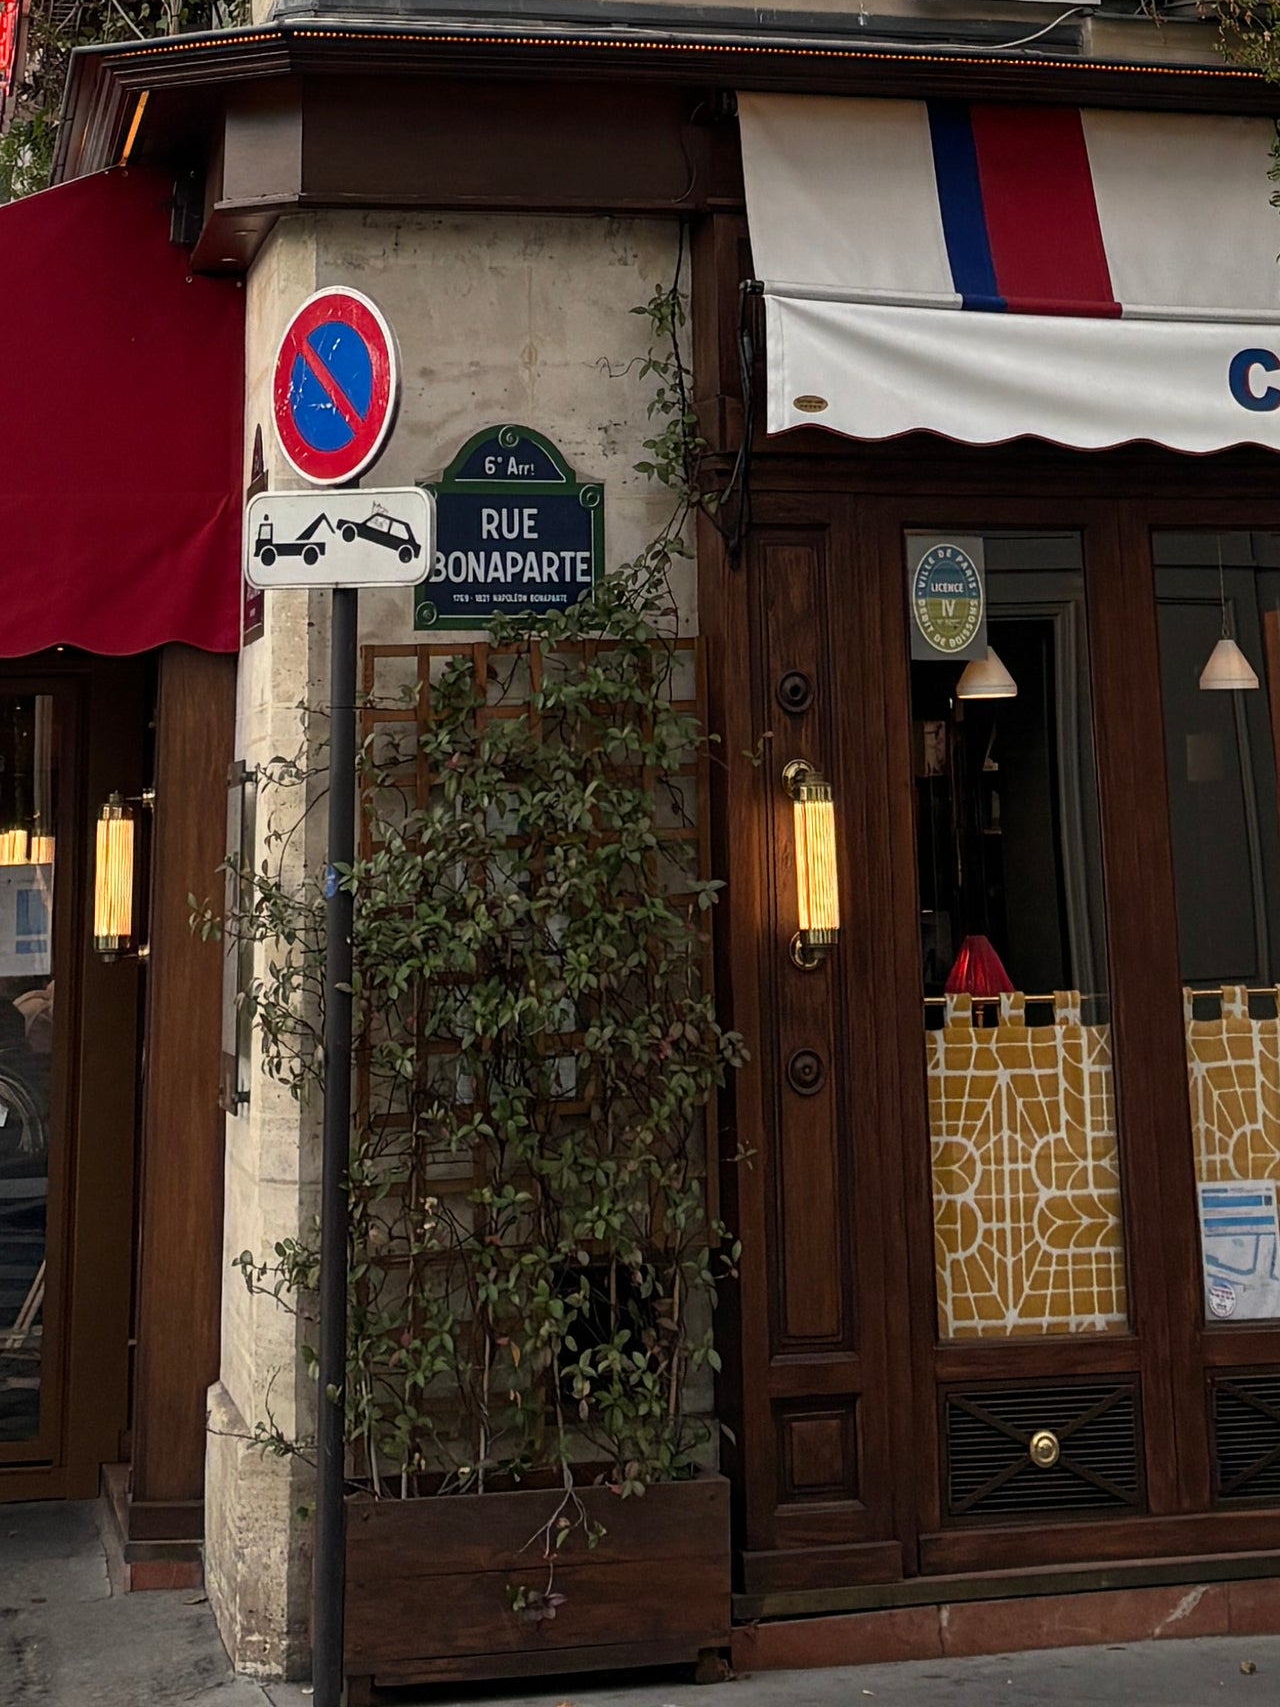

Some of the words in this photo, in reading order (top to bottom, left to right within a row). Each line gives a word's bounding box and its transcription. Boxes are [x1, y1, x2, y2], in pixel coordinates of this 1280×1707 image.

[481, 508, 538, 540] RUE
[429, 550, 591, 583] BONAPARTE
[917, 556, 936, 588] VILLE
[937, 548, 952, 558] DE
[955, 554, 977, 589] PARIS
[530, 593, 567, 603] BONAPARTE
[931, 582, 964, 593] LICENCE
[941, 599, 956, 617] IV
